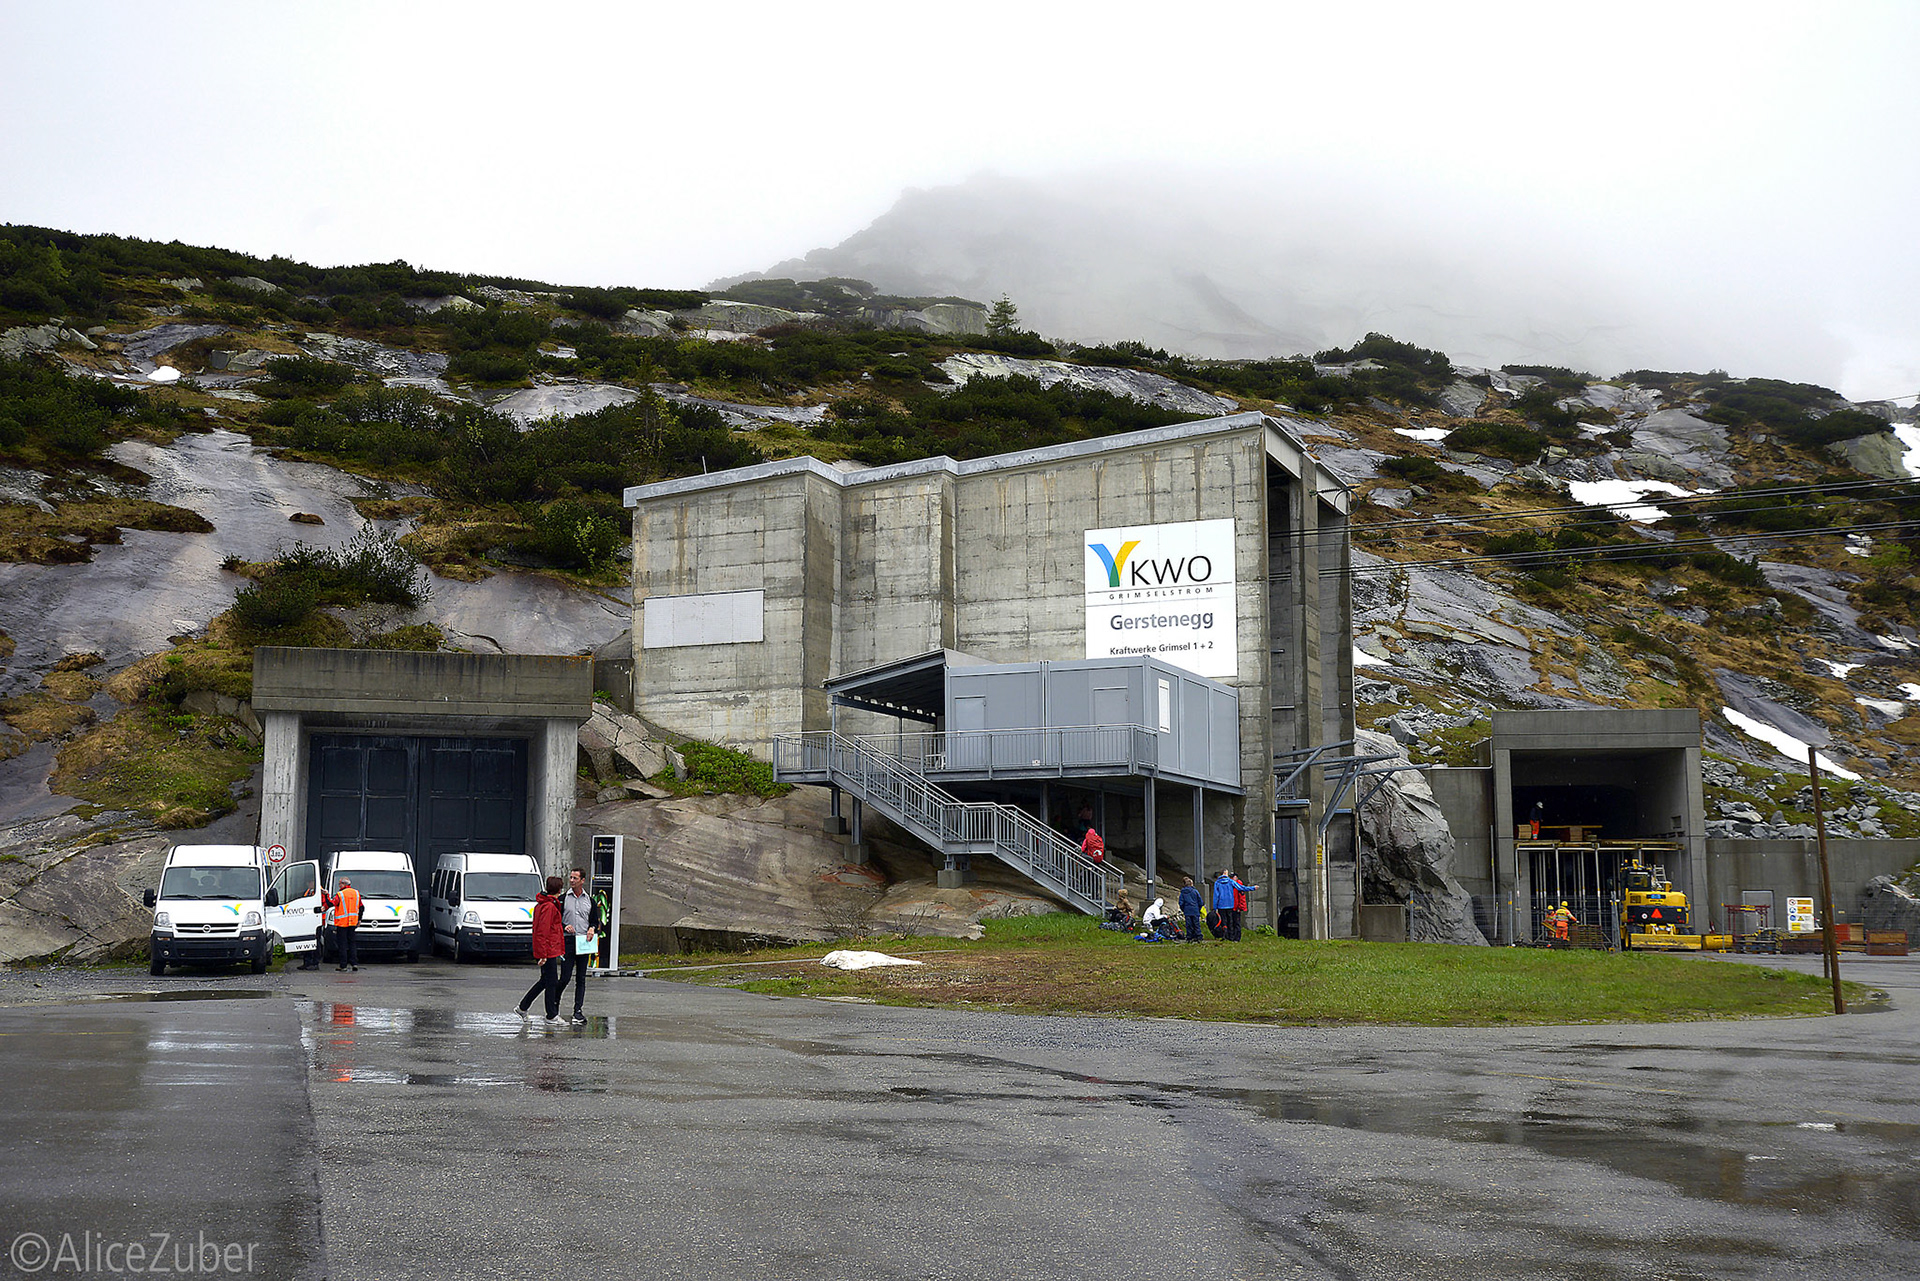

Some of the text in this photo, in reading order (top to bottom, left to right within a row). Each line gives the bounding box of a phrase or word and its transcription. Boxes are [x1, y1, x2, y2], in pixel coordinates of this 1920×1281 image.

[1131, 555, 1212, 586] KWO
[1109, 587, 1213, 600] GRIMSELSTROM
[1110, 612, 1213, 630] Gerstenegg
[1110, 644, 1157, 655] Kraftwerke
[1158, 642, 1191, 652] Grimsel
[1193, 642, 1198, 650] 1
[1208, 641, 1214, 649] 2
[286, 907, 305, 915] KWO
